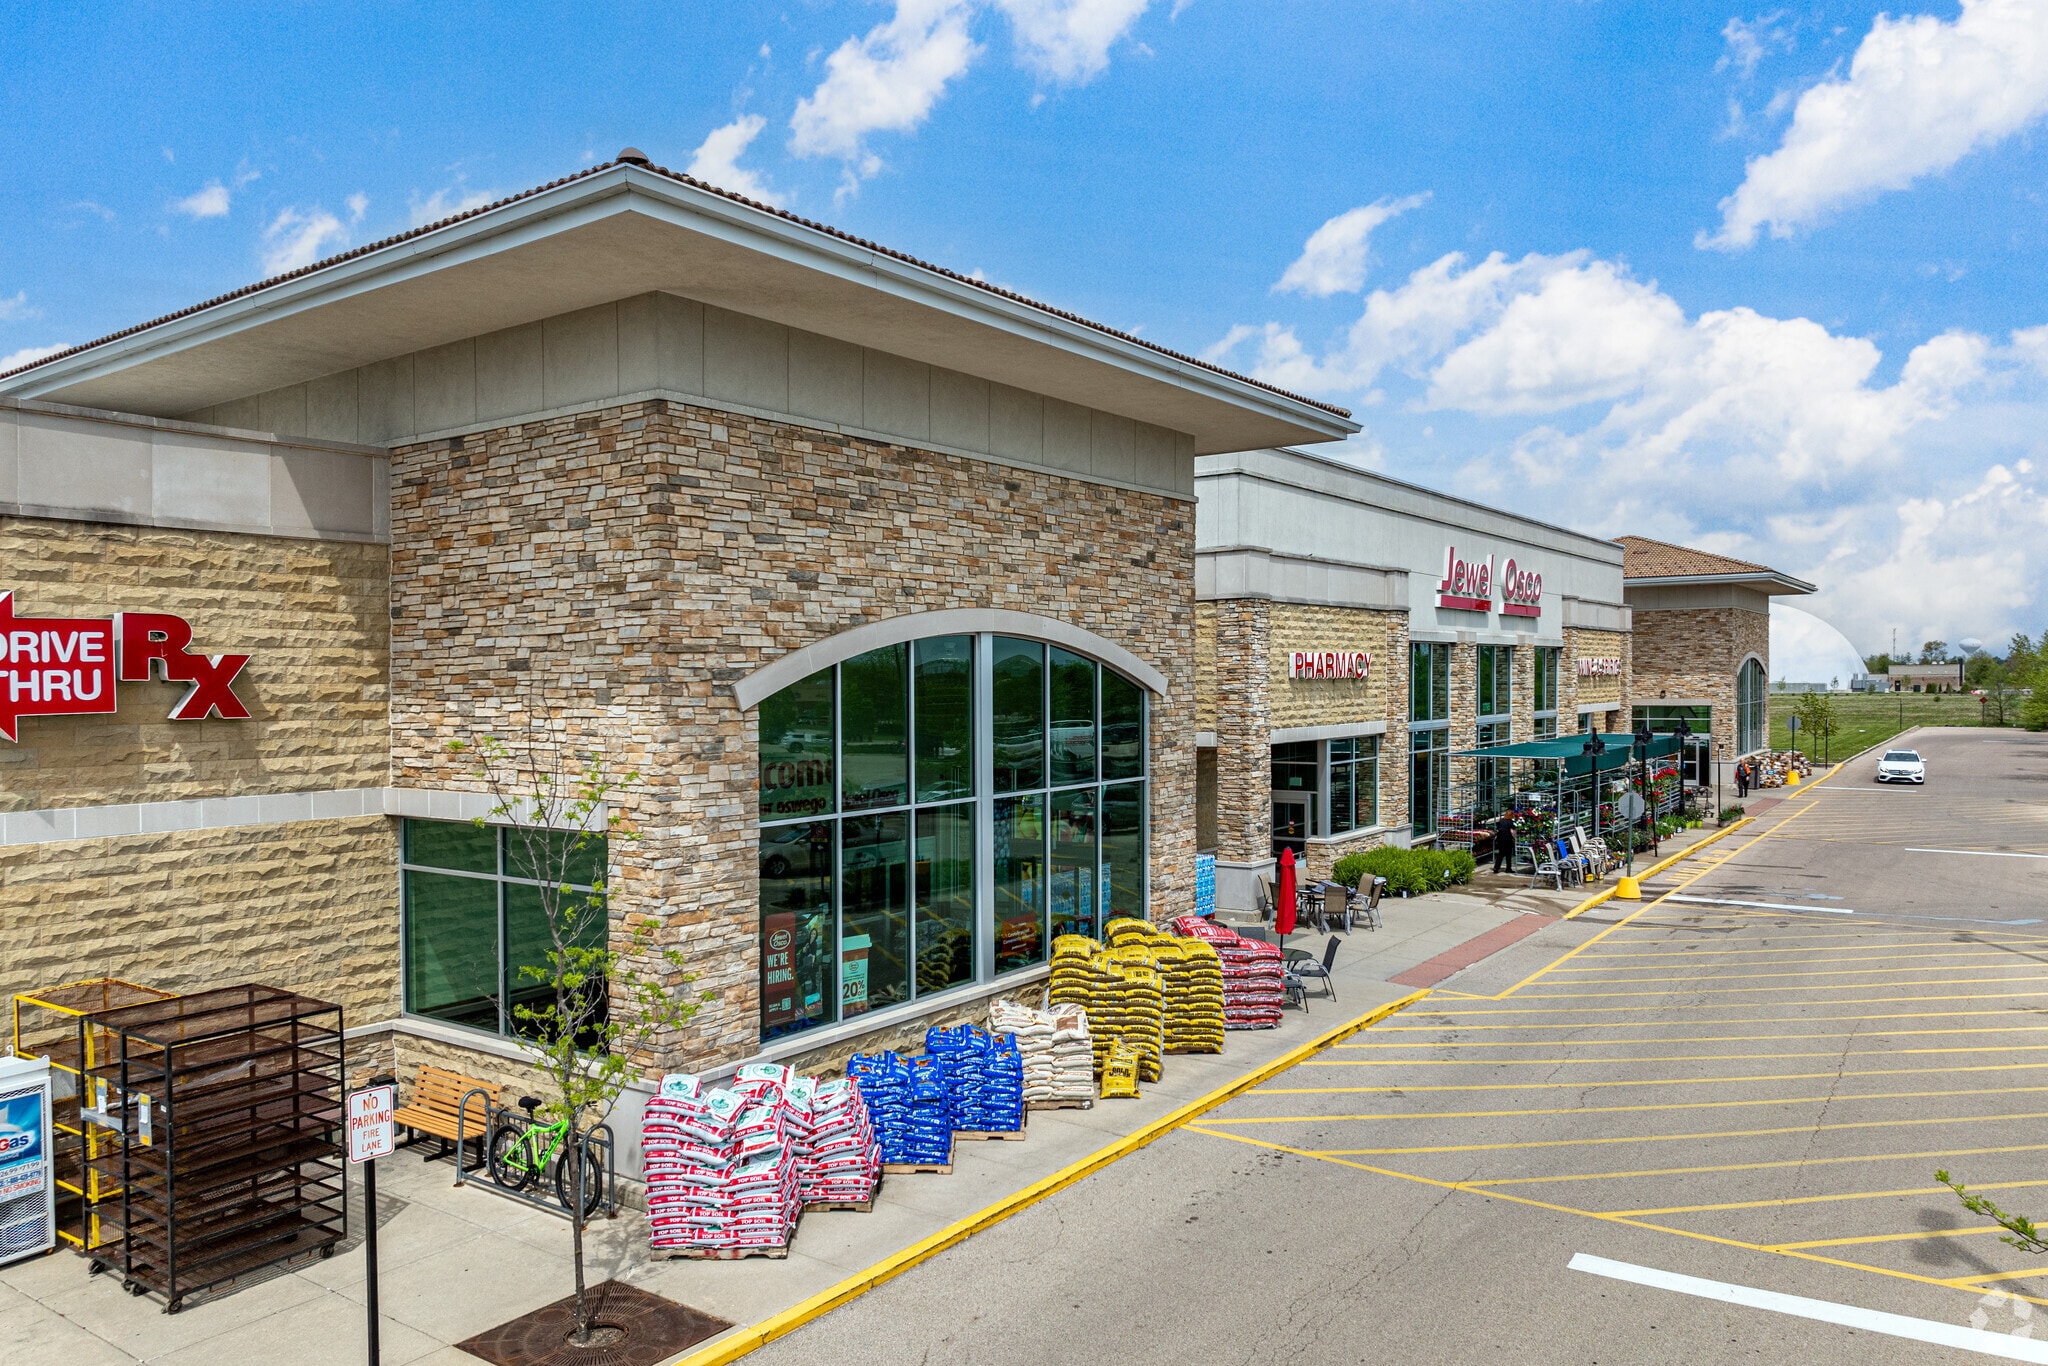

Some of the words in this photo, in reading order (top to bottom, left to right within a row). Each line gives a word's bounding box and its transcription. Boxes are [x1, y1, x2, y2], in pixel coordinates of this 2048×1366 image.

[1441, 546, 1495, 597] Jewel
[1503, 558, 1542, 602] Osco
[1293, 652, 1372, 679] PHARMACY
[767, 952, 789, 968] WE'RE
[767, 967, 794, 985] HIRING.
[363, 1096, 378, 1111] NO
[352, 1109, 390, 1130] PARKING
[363, 1127, 380, 1140] FIRE
[361, 1139, 382, 1153] LANE
